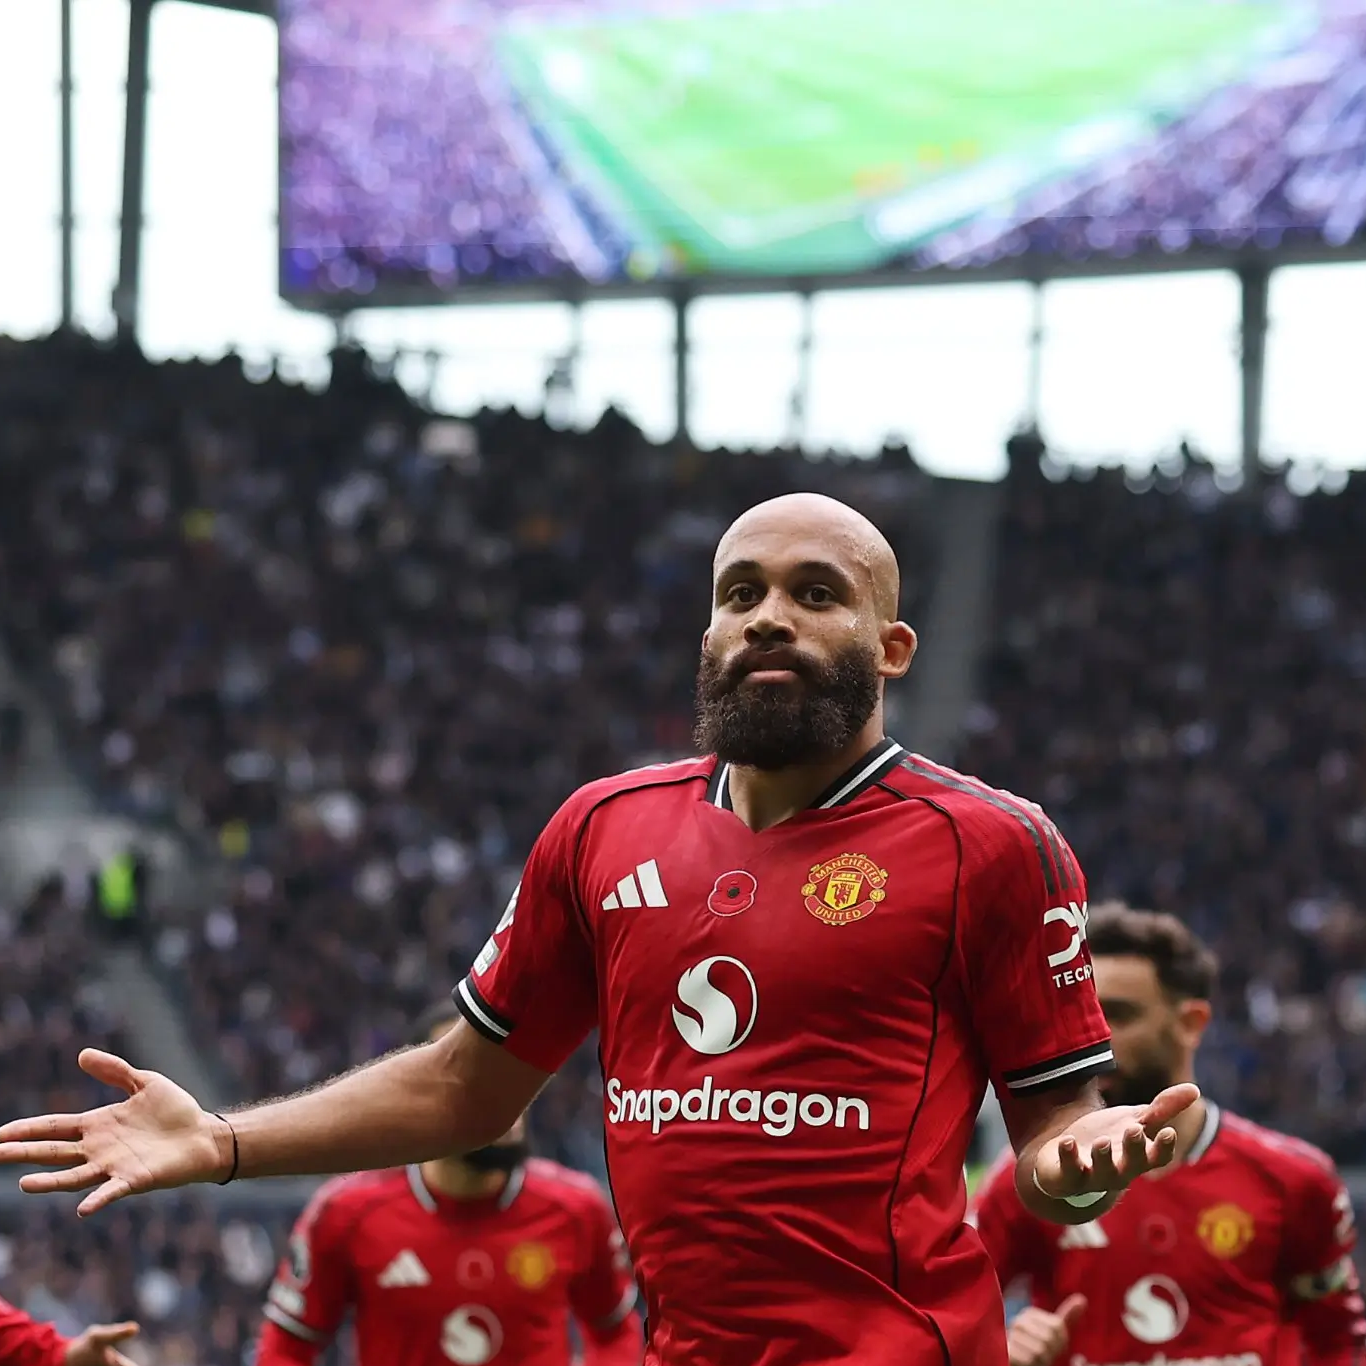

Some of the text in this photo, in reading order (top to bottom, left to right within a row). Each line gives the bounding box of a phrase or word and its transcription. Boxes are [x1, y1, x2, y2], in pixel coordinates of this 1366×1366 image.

[815, 858, 881, 884] MANCHESTER
[815, 906, 861, 920] UNITED
[607, 1076, 870, 1137] Snapdragon
